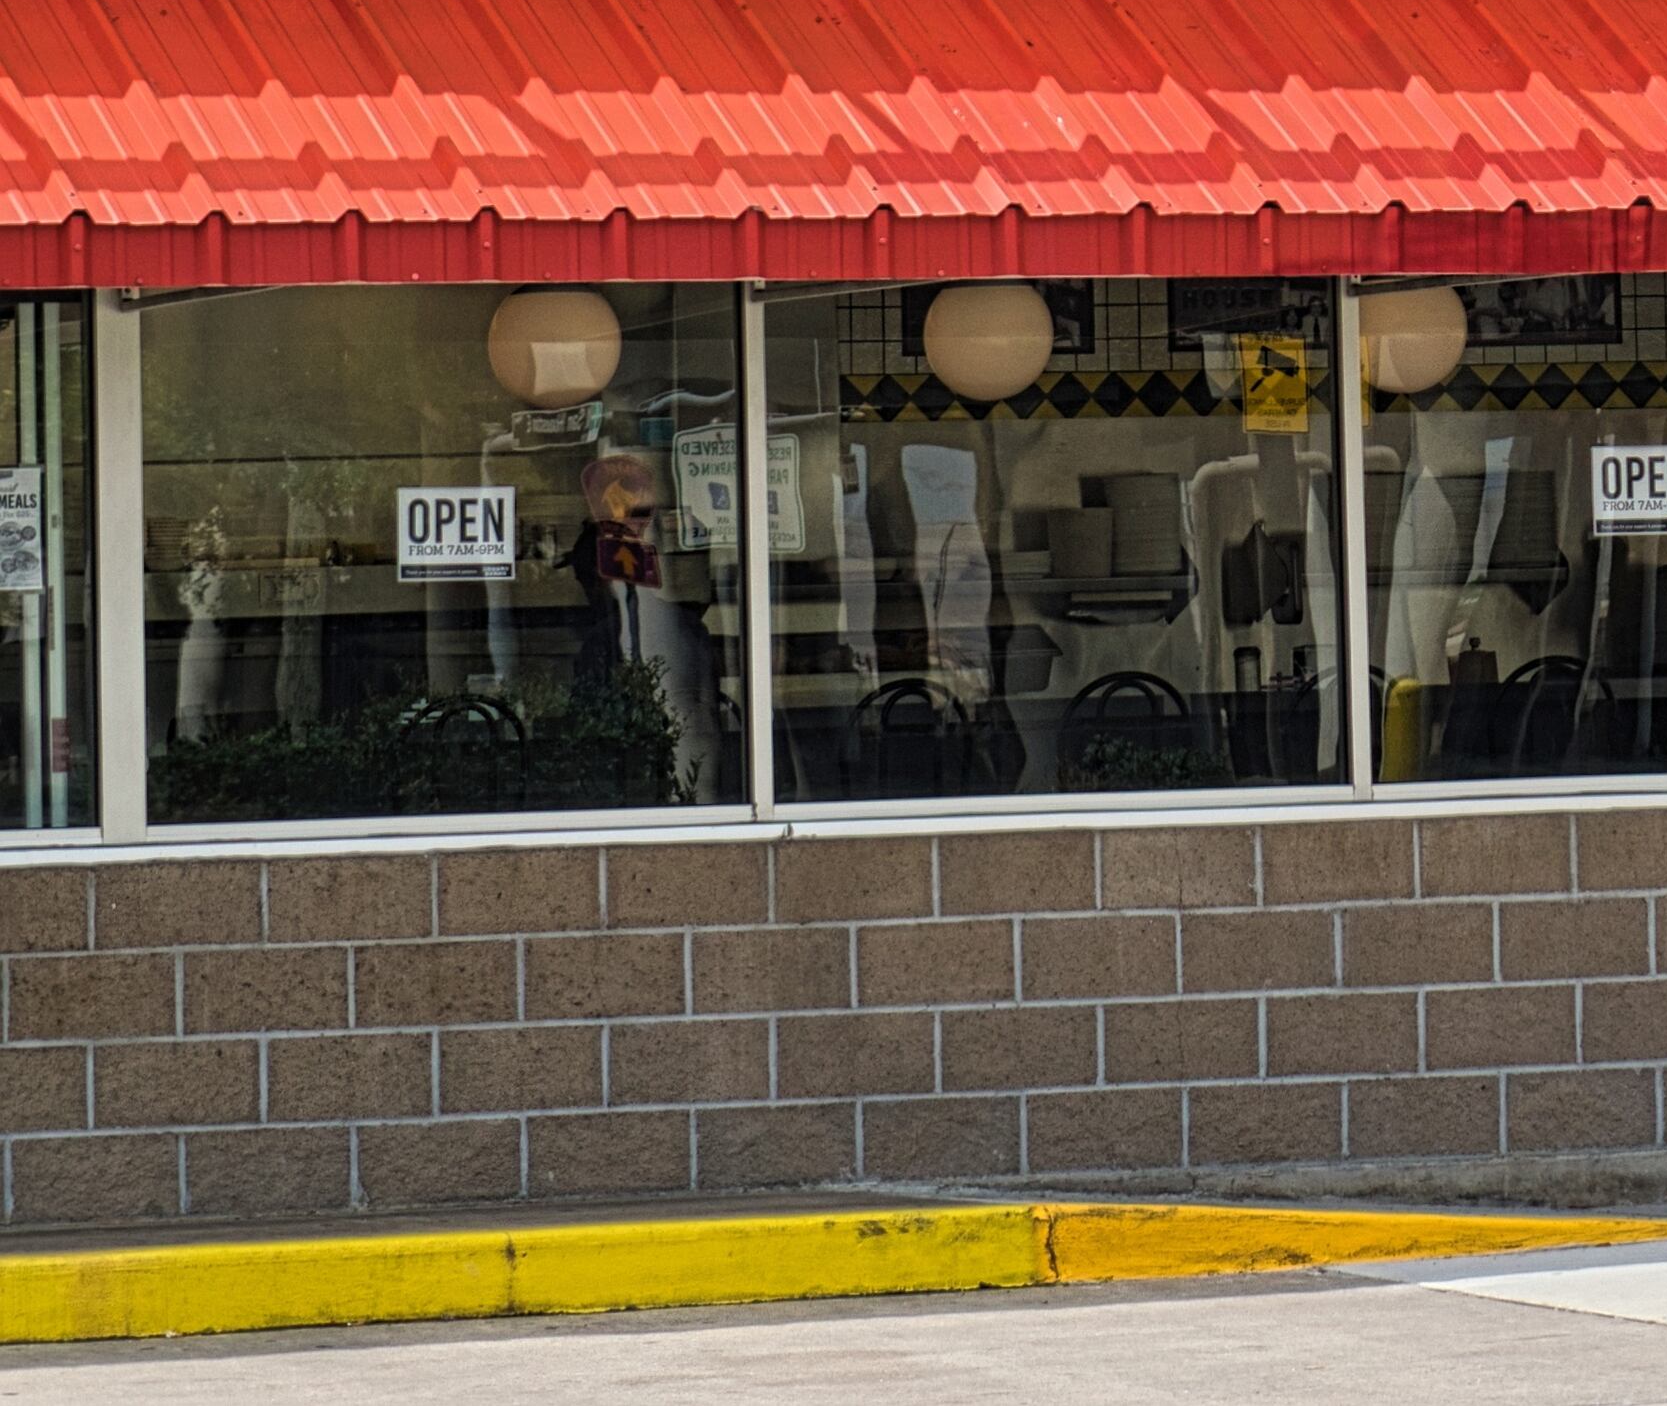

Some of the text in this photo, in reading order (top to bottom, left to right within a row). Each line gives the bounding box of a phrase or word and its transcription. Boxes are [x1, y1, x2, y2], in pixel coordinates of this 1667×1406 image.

[1602, 501, 1636, 512] FROM
[408, 497, 505, 544] OPEN
[408, 543, 505, 557] FROM 7AM-9PM
